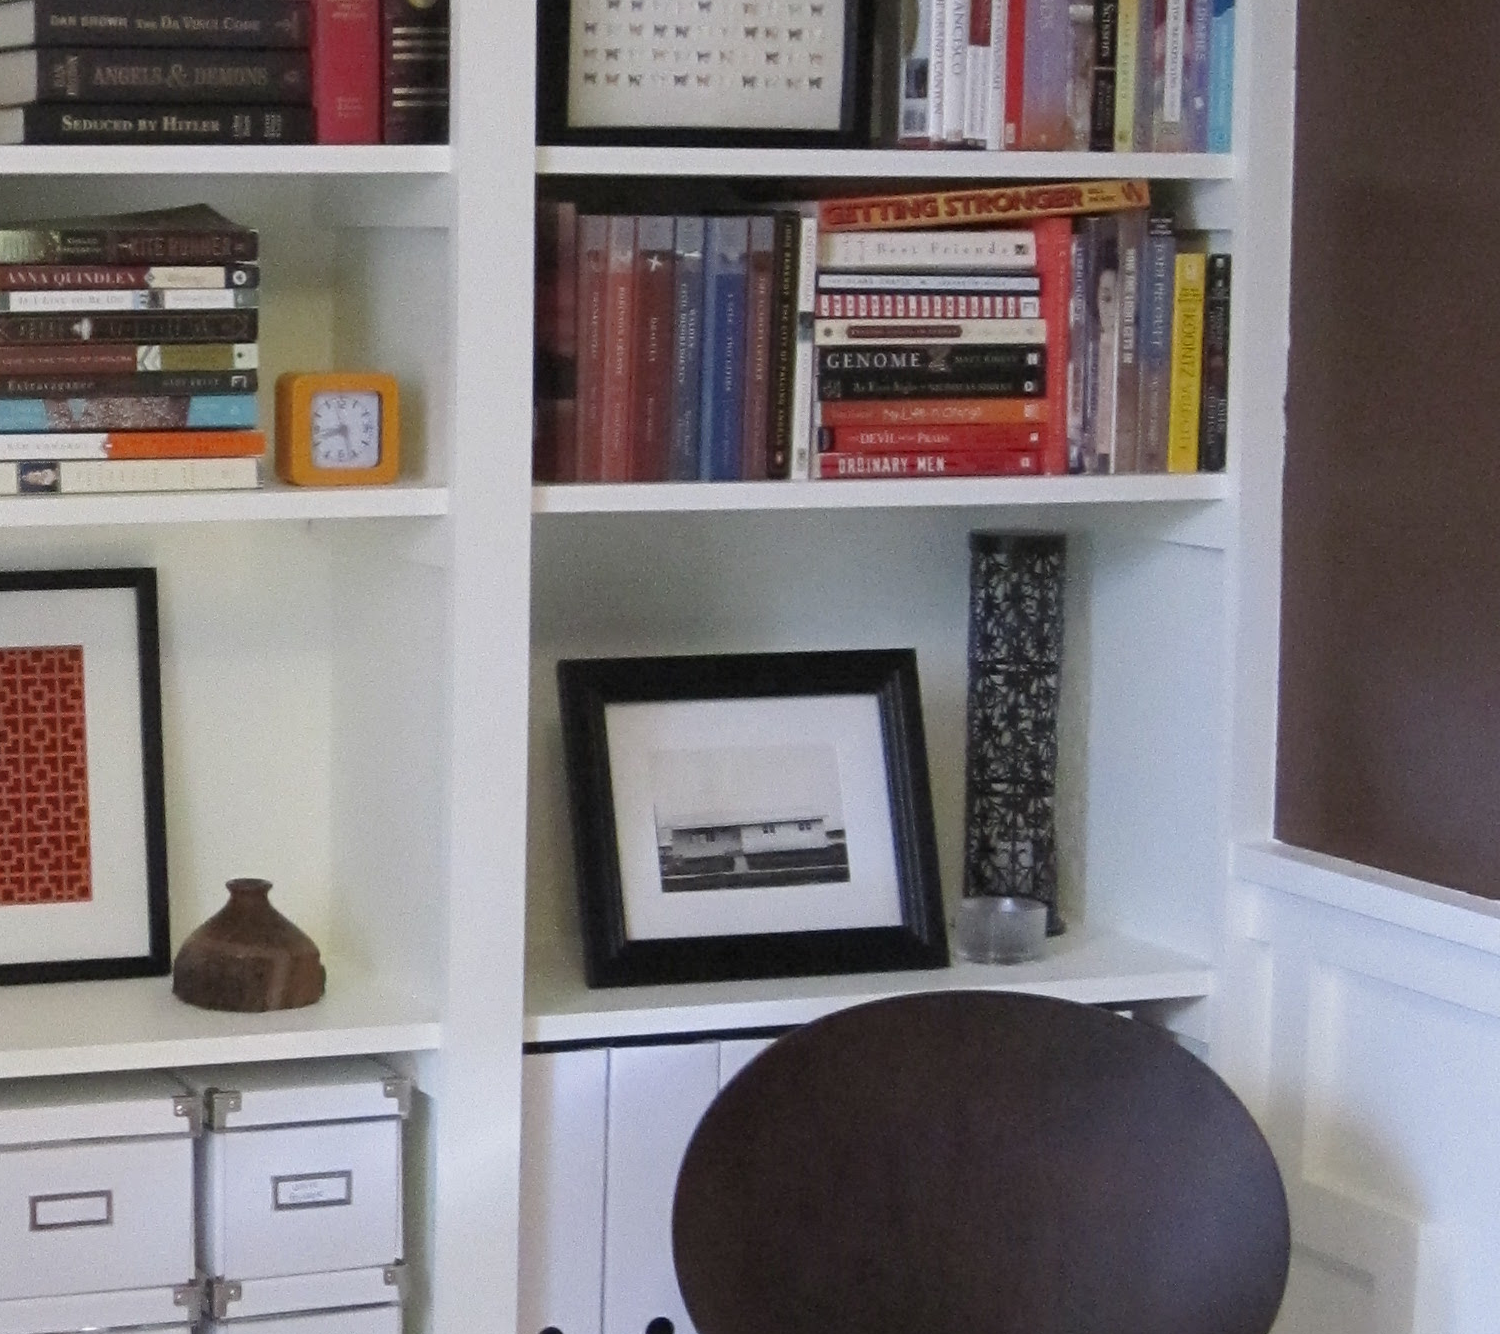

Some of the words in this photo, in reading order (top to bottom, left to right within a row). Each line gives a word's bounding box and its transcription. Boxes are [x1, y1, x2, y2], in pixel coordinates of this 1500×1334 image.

[92, 65, 163, 86] ANGELS
[194, 66, 269, 85] DEMONS
[61, 114, 133, 132] SEDUCED
[137, 119, 156, 131] BY
[162, 115, 221, 131] HITLER
[825, 196, 940, 226] GETTING
[943, 186, 1084, 218] STRONGER
[930, 242, 1008, 256] Friends
[7, 271, 47, 284] ANNA
[53, 271, 136, 286] QUINDLEN
[826, 351, 922, 369] GENOME
[838, 456, 909, 473] ORDINARY
[917, 455, 945, 472] MEN
